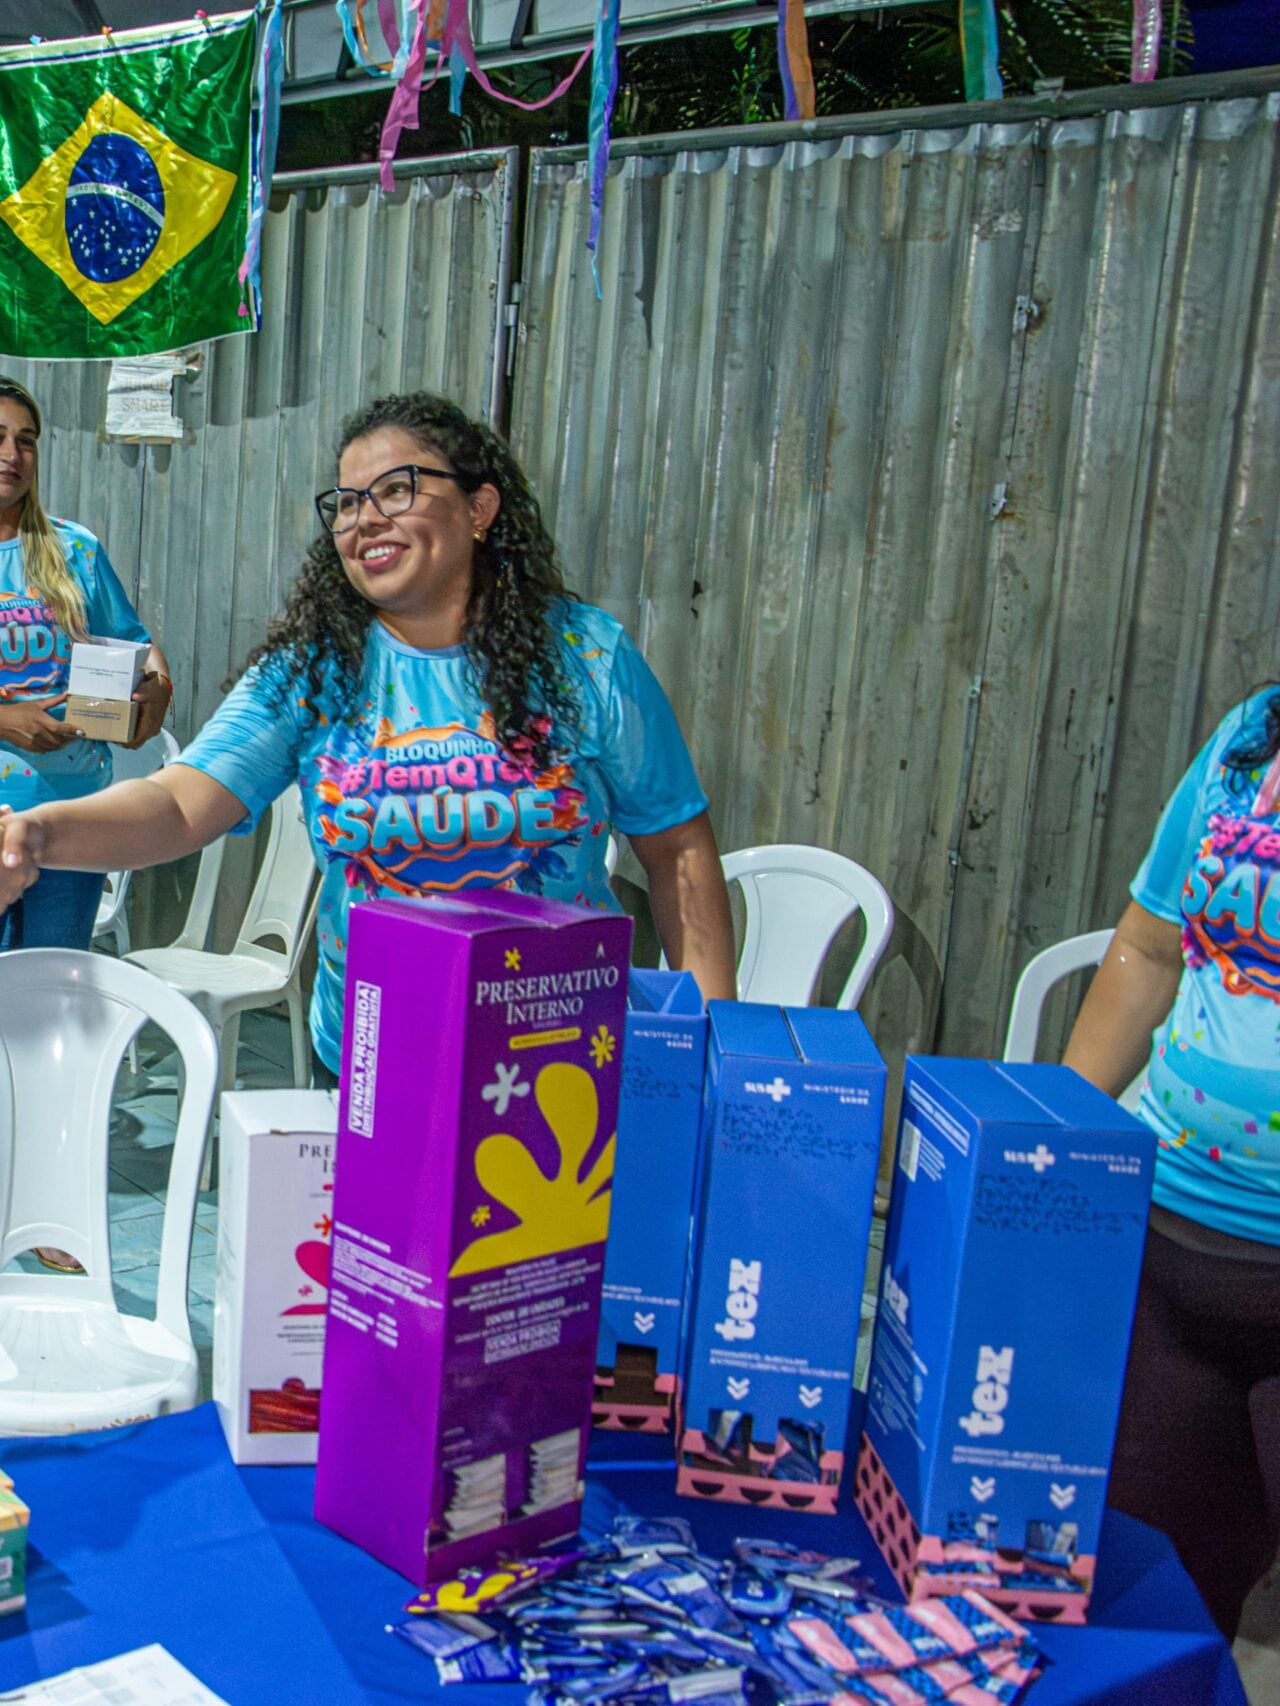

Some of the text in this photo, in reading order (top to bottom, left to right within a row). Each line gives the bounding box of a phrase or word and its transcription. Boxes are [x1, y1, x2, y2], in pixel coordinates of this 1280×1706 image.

[385, 738, 496, 763] BLOQUINHO
[340, 754, 536, 793] #TemQTe
[333, 785, 557, 854] SAÚDE
[475, 965, 619, 1006] PRESERVATIVO
[506, 997, 584, 1025] INTERNO
[350, 986, 371, 1128] VENDA PROIBIDA
